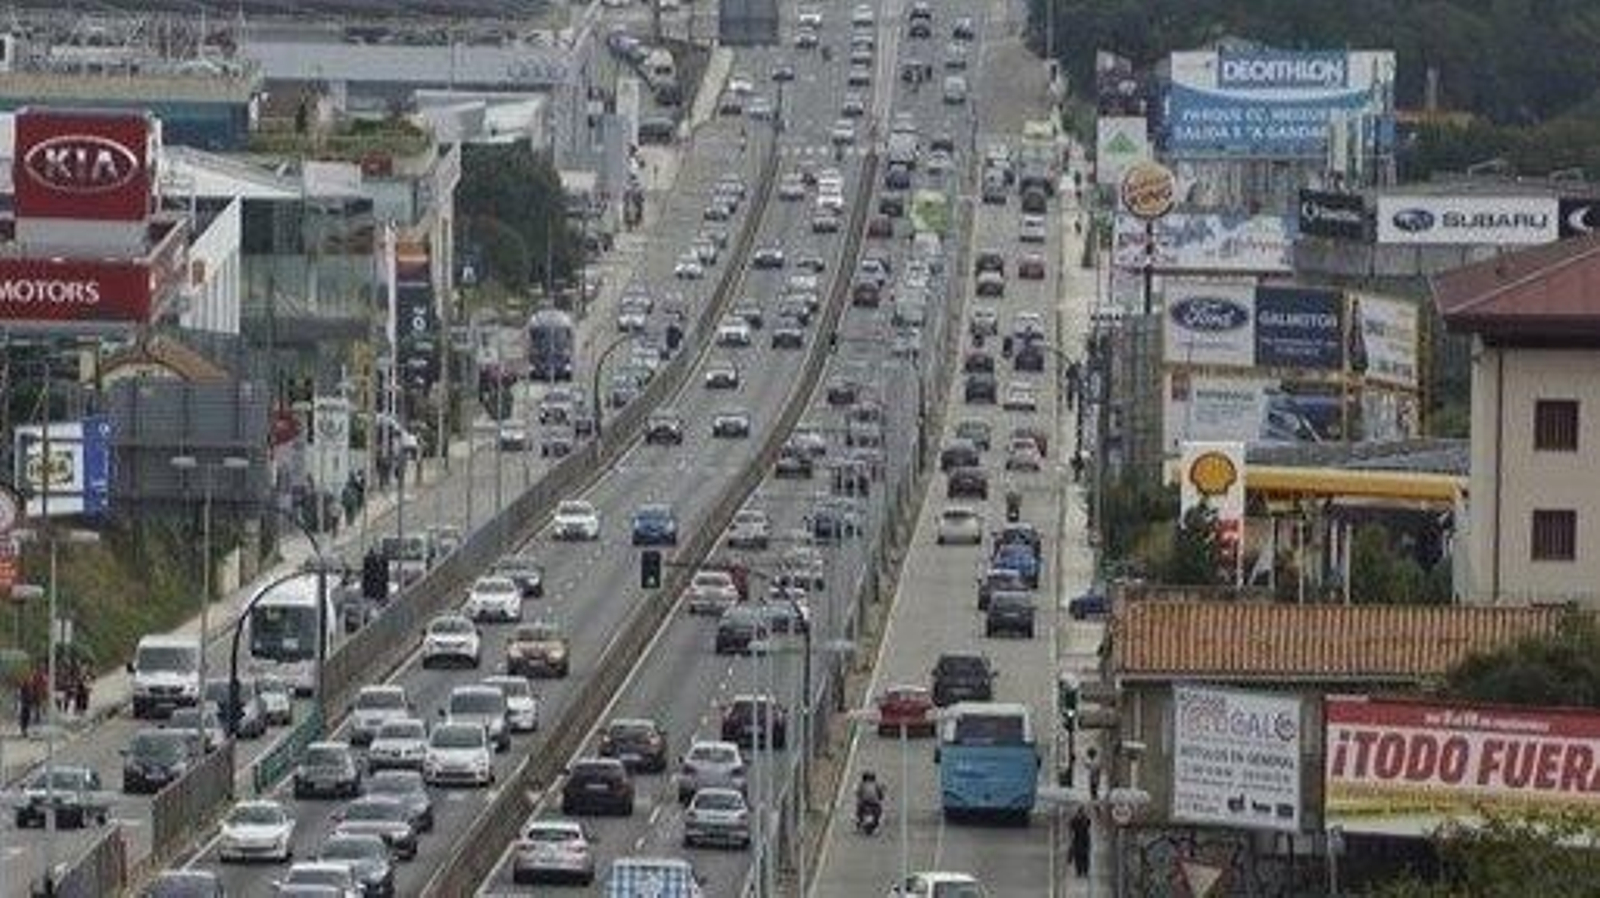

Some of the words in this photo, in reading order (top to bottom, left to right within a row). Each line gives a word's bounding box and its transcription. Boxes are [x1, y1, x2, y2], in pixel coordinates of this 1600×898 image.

[44, 148, 118, 180] KIA
[1442, 211, 1547, 228] SUBARU
[0, 279, 100, 303] MOTORS
[1183, 300, 1235, 326] Ford
[1331, 729, 1470, 785] ¡TODO
